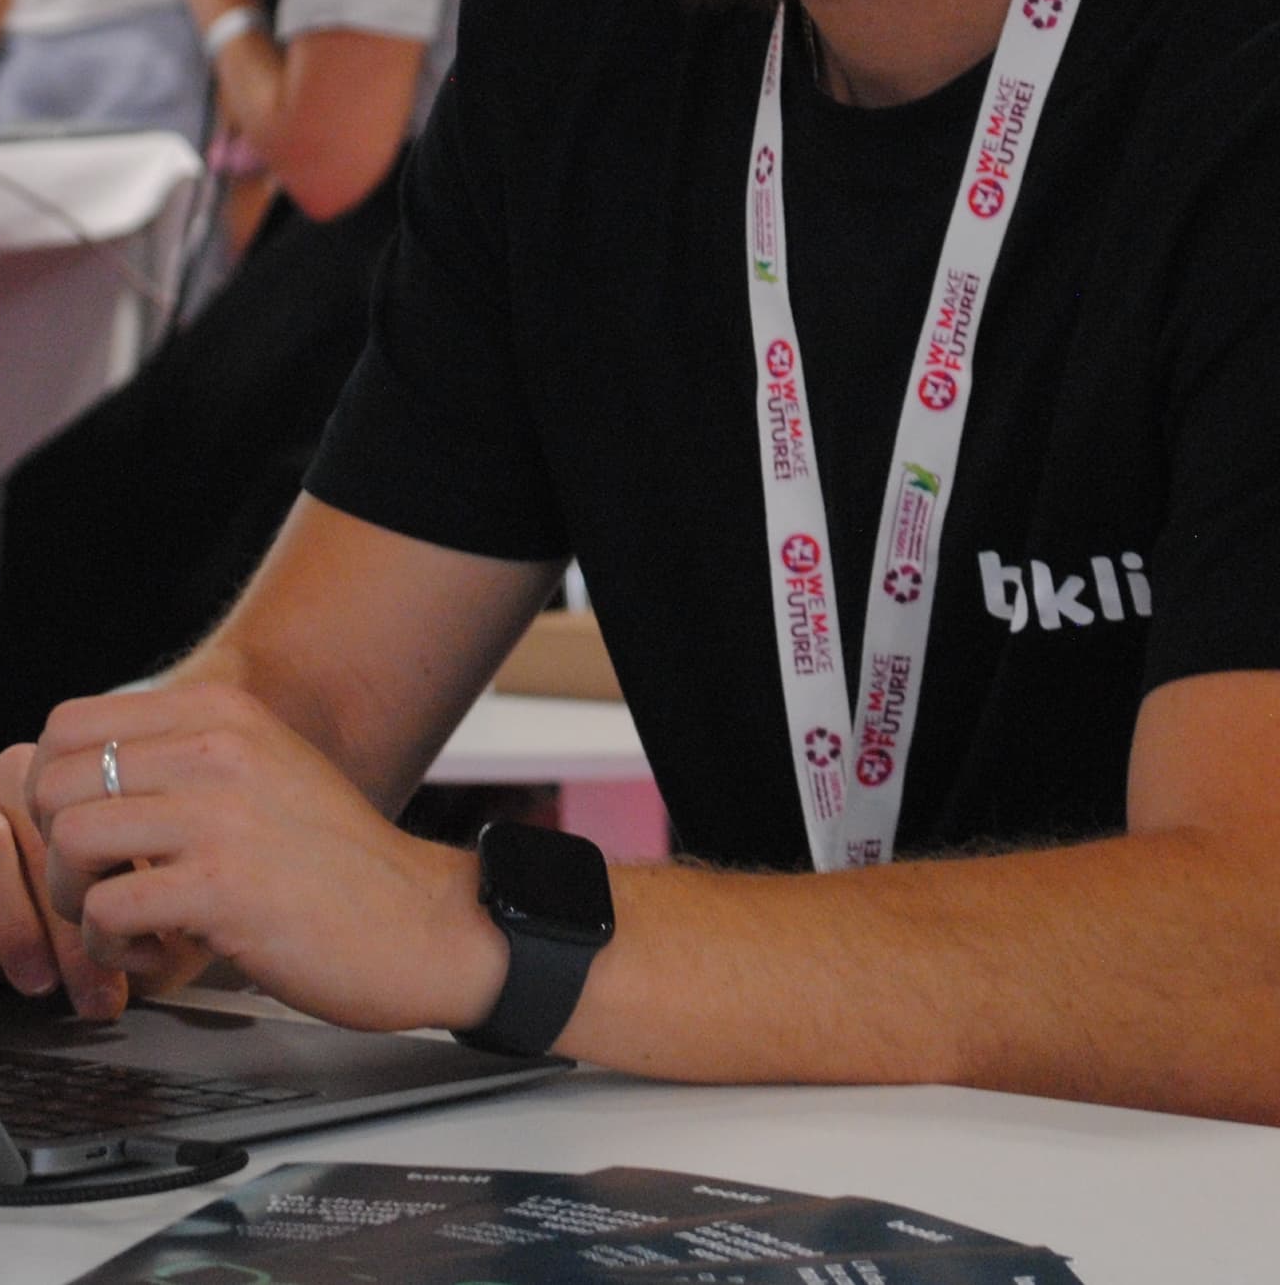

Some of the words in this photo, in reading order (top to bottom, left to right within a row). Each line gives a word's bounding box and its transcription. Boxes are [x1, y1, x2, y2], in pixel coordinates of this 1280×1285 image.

[986, 73, 1018, 138] MAKE
[992, 79, 1036, 180] FUTURE!
[975, 138, 999, 174] WE
[936, 267, 964, 330] MAKE
[944, 272, 982, 371] FUTURE!
[924, 330, 951, 366] WE
[782, 377, 801, 414] WE
[766, 381, 792, 481] FUTURE!
[788, 417, 810, 479] MAKE
[806, 572, 827, 611] WE
[785, 576, 816, 676] FUTURE!
[810, 612, 835, 675] MAKE
[866, 653, 891, 713] MAKE
[878, 655, 912, 748] FUTURE!
[861, 714, 883, 747] WE
